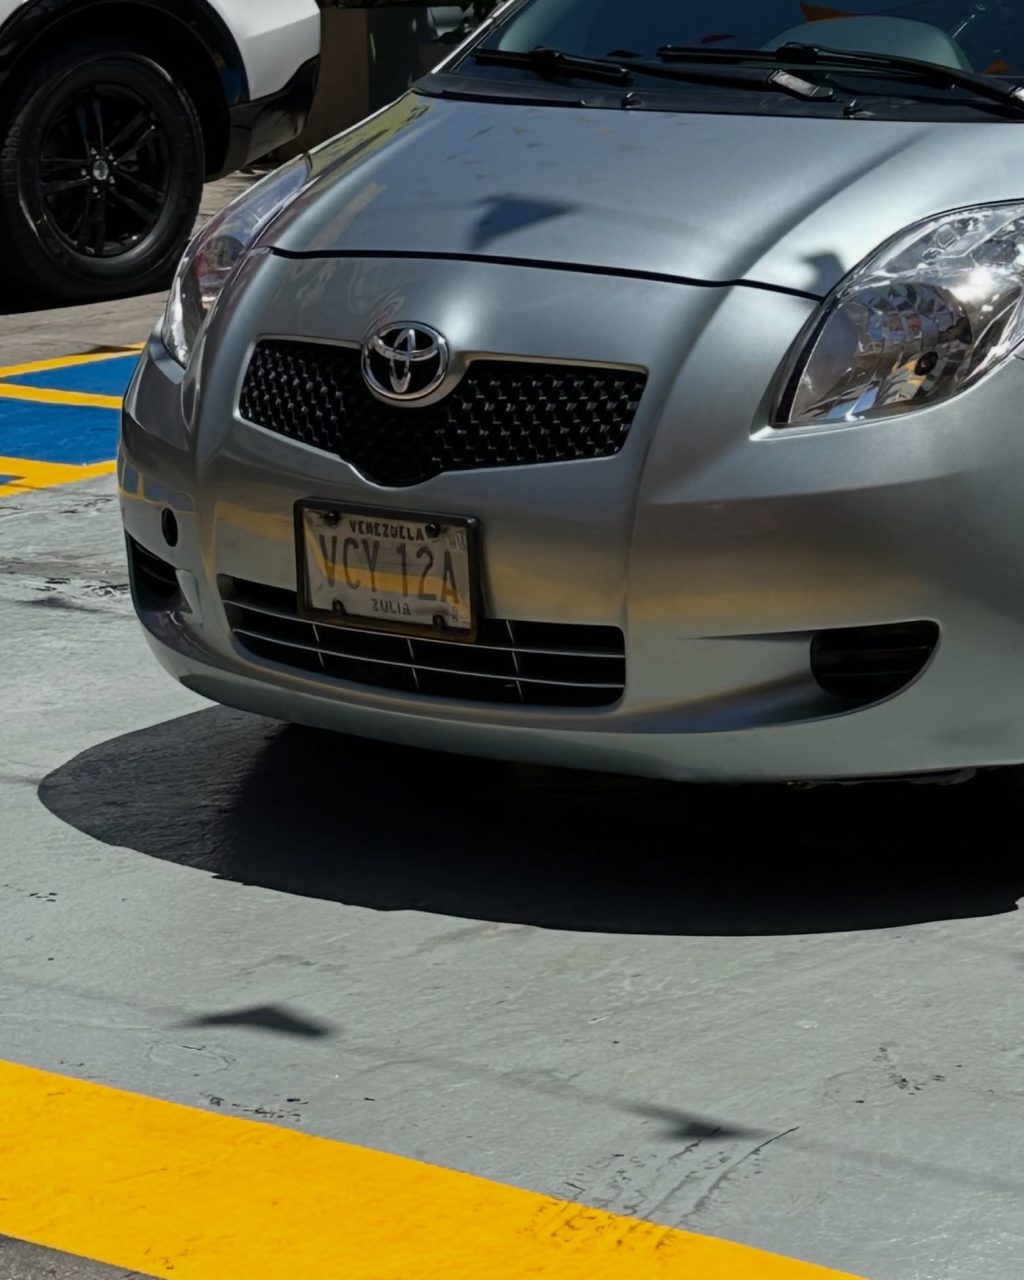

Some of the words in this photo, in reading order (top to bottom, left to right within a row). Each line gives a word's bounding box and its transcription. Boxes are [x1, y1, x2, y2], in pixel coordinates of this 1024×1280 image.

[348, 519, 425, 542] VENEZUELA
[318, 534, 380, 593] VCY
[396, 543, 460, 605] 12A
[371, 598, 412, 617] ZULIA
